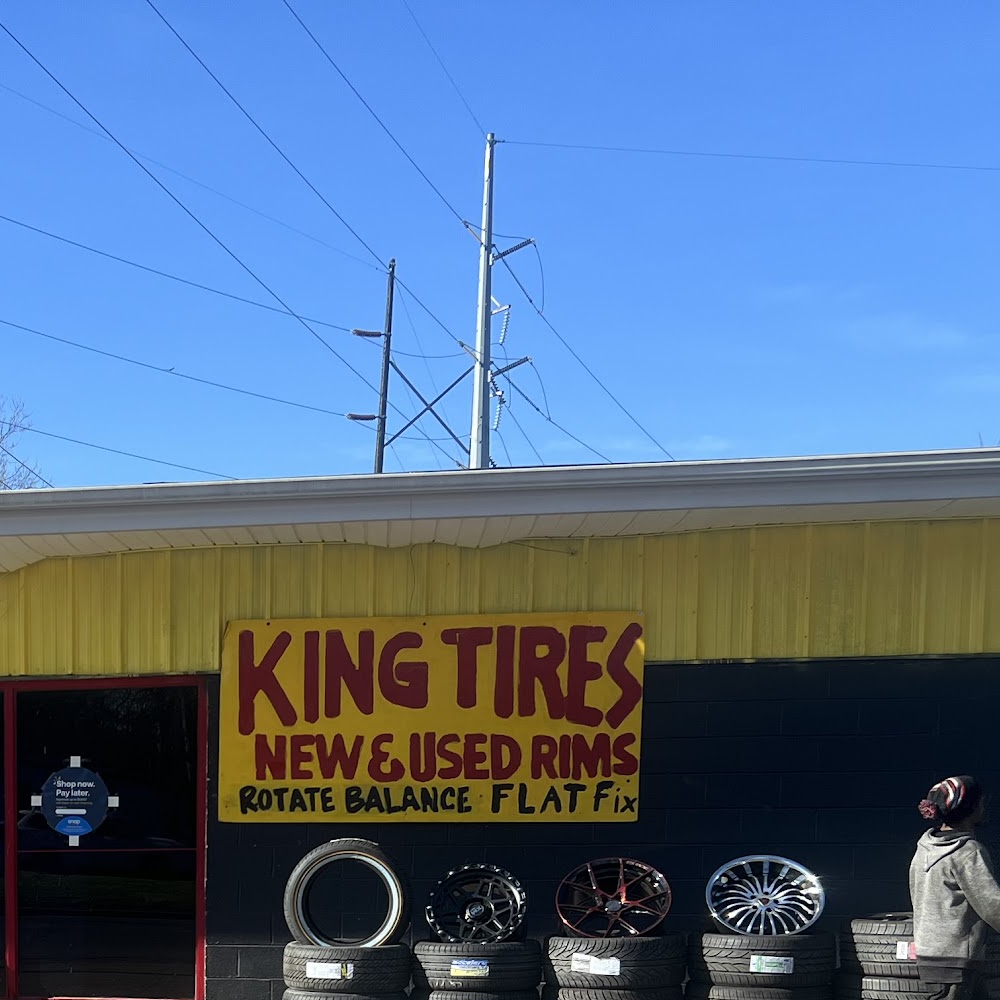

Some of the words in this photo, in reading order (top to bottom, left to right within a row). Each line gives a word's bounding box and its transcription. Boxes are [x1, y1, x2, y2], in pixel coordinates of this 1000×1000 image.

[238, 629, 429, 735] KING
[440, 622, 643, 729] TIRES
[255, 733, 364, 780] NEW
[368, 733, 405, 782] &
[410, 732, 522, 782] USED
[531, 733, 638, 781] RIMS
[56, 780, 76, 788] Shop
[56, 789, 70, 798] Pay
[71, 789, 90, 797] later.
[239, 785, 334, 814] ROTATE
[345, 785, 472, 814] BALANCE
[491, 782, 587, 814] FLAT
